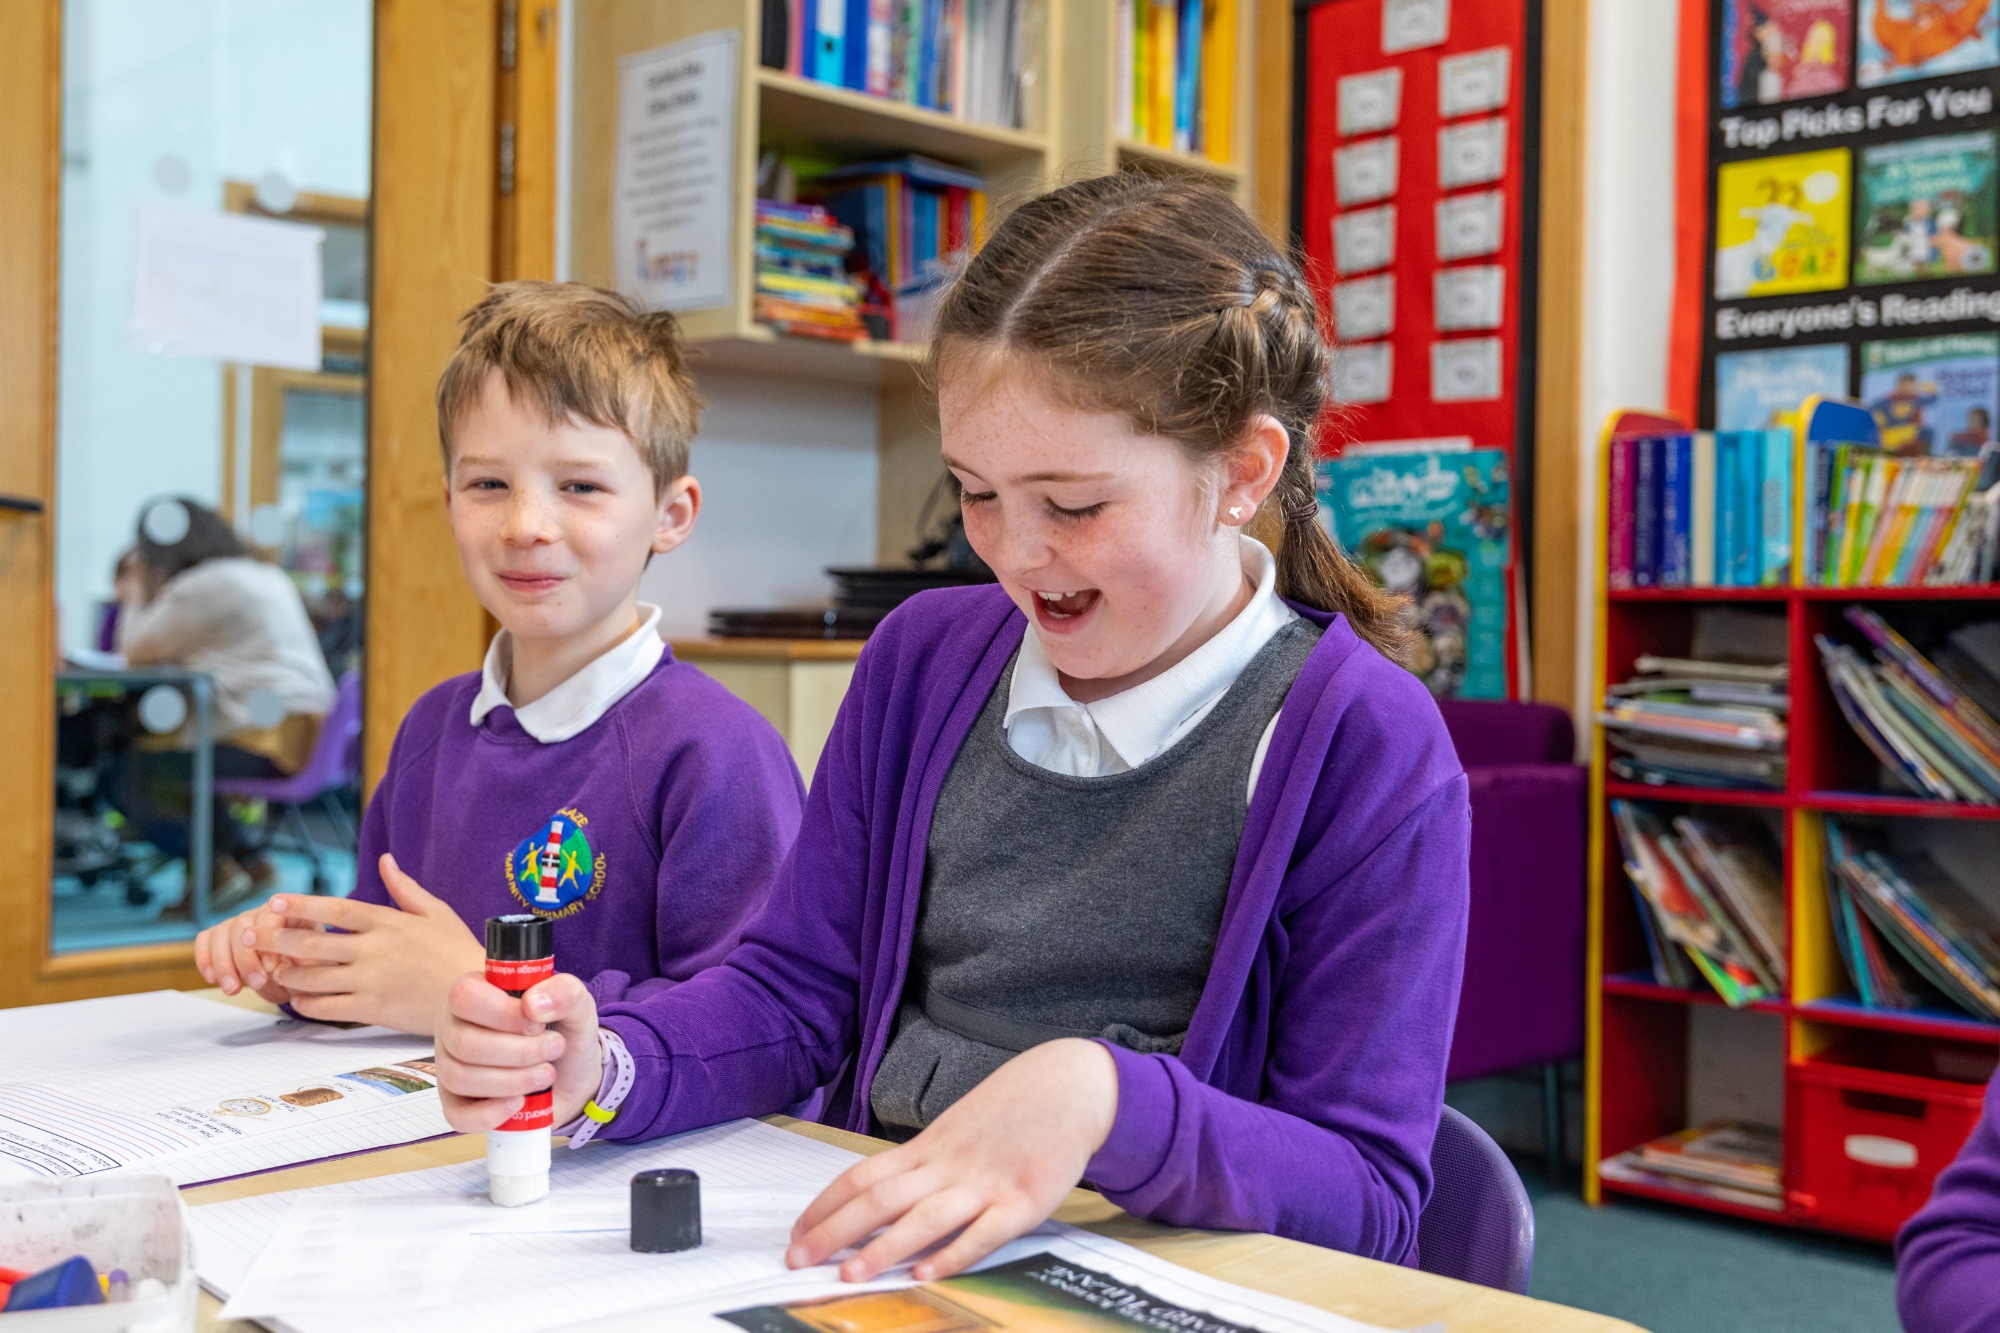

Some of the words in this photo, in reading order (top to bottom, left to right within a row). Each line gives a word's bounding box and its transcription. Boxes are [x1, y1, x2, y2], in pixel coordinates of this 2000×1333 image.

[1720, 115, 1779, 149] Top
[1781, 103, 1865, 141] Picks
[1866, 96, 1924, 129] For
[1924, 86, 1993, 121] You
[1715, 295, 1879, 340] Everyone's
[1880, 287, 2000, 327] Reading
[585, 852, 607, 900] SCHOOL
[492, 966, 516, 975] videos
[517, 965, 542, 975] usage
